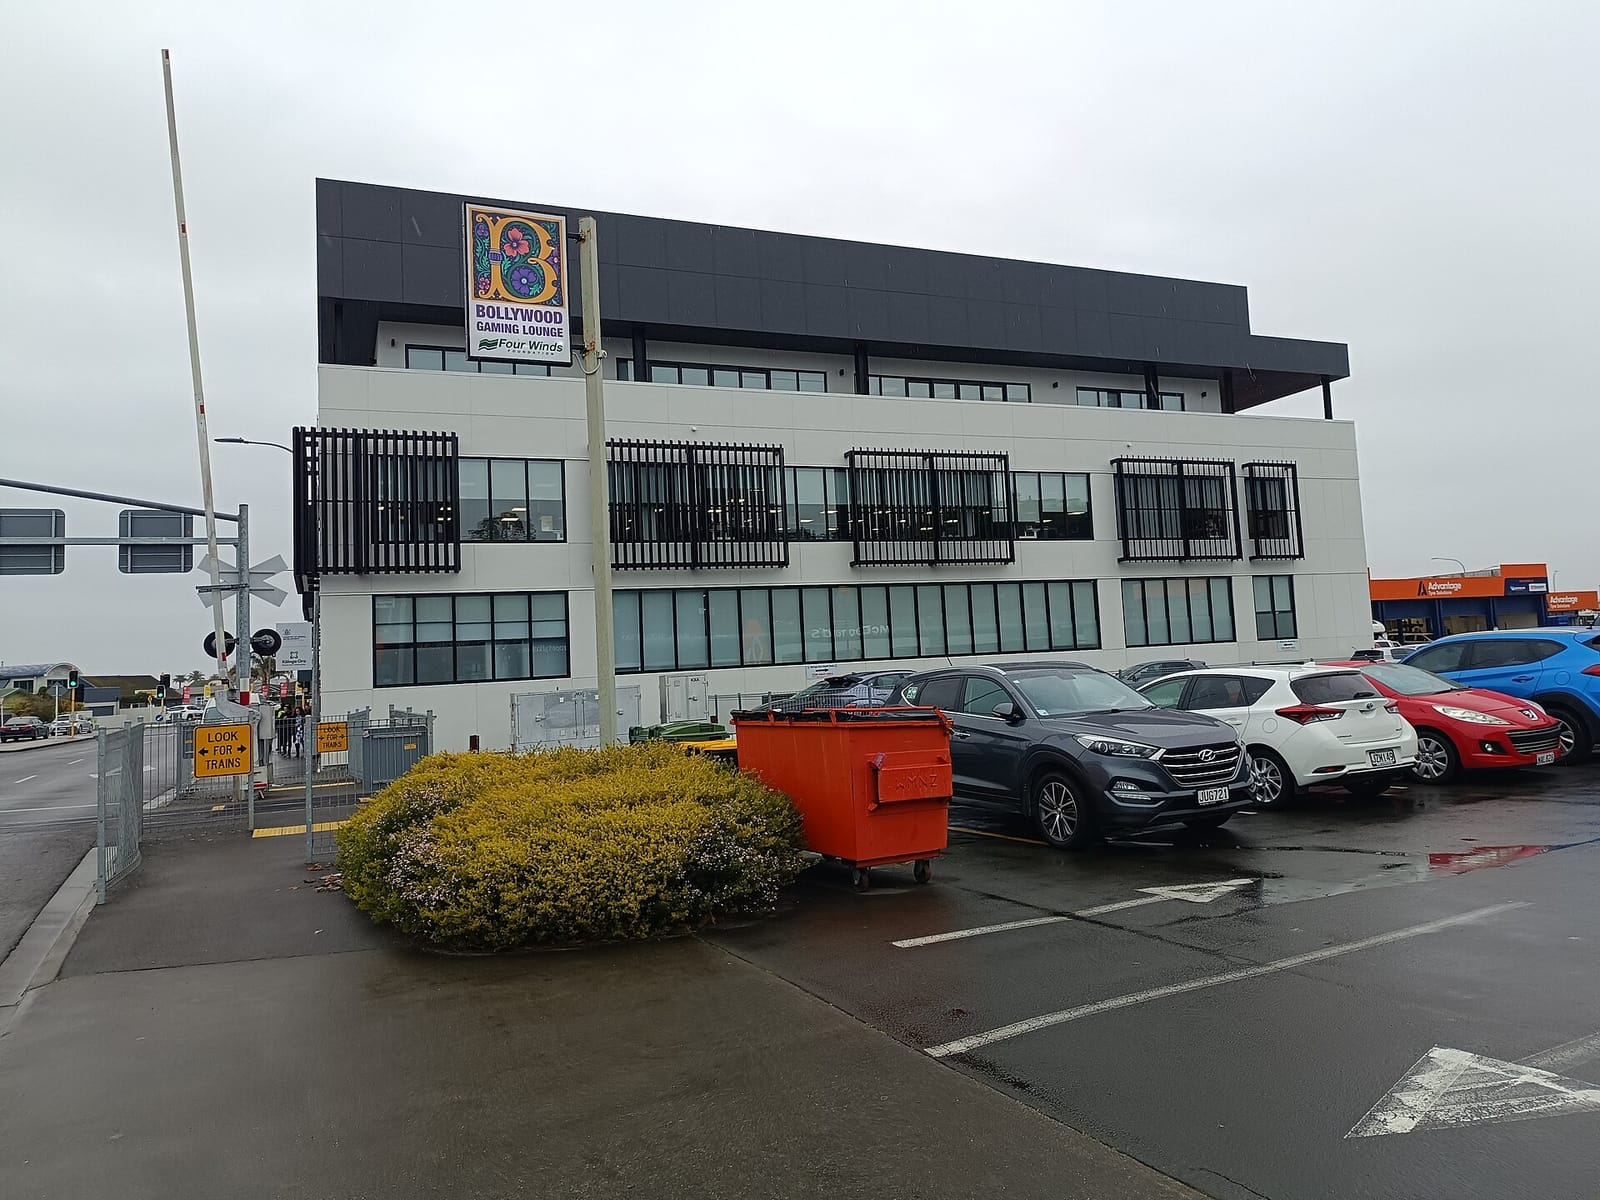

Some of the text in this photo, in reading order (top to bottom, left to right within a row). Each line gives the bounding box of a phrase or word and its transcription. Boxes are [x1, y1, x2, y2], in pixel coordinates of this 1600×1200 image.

[476, 304, 563, 324] BOLLYWOOD
[477, 321, 564, 338] GAMING LOUNGE
[499, 338, 564, 352] Four Winds
[1428, 582, 1462, 592] Advantage
[1549, 596, 1578, 604] Advantage
[207, 731, 239, 743] LOOK
[213, 744, 233, 756] FOR
[322, 741, 342, 749] TRAINS
[205, 757, 241, 770] TRAINS
[1199, 788, 1228, 802] JUG721
